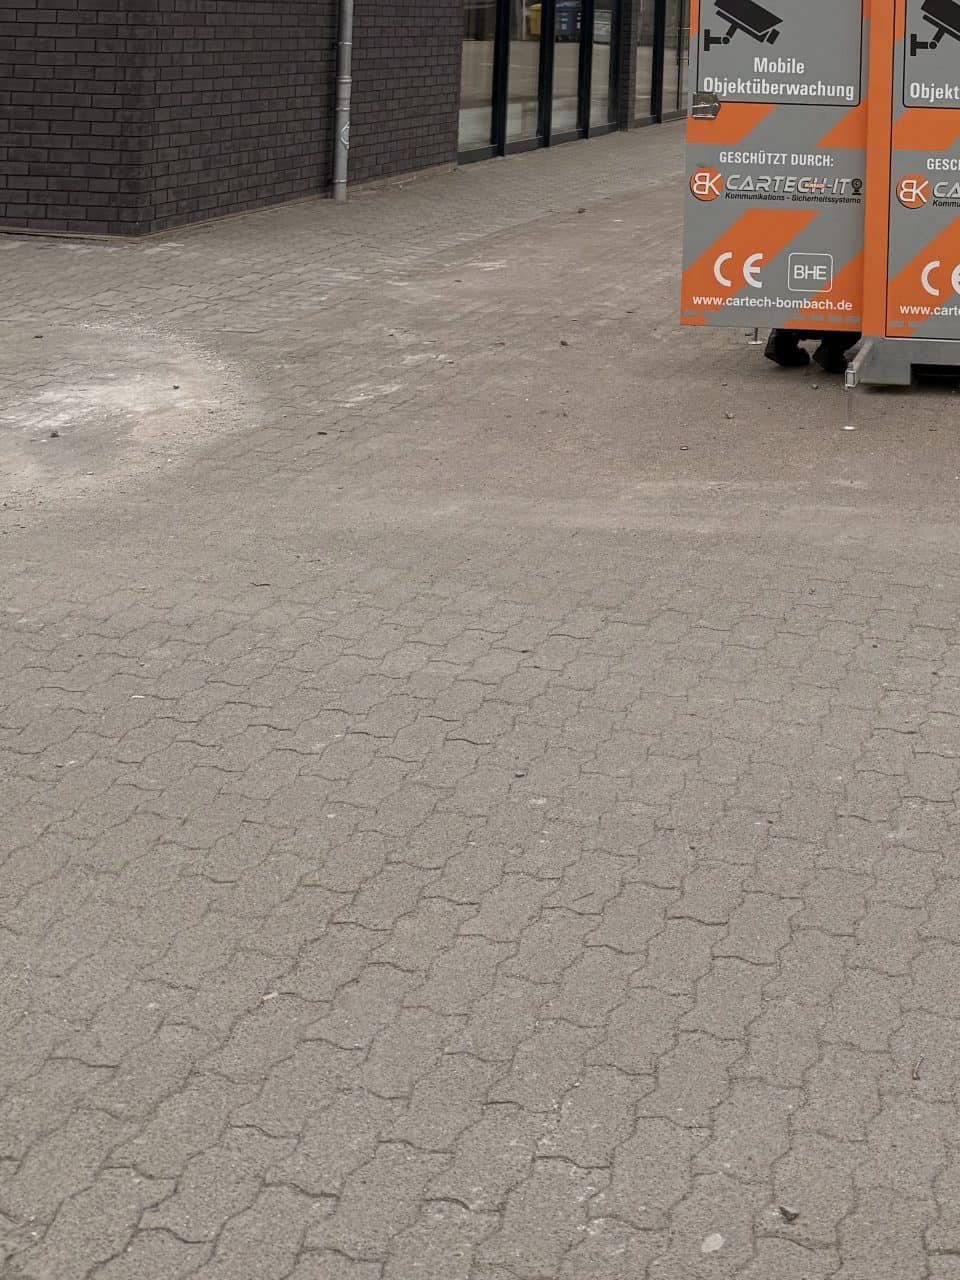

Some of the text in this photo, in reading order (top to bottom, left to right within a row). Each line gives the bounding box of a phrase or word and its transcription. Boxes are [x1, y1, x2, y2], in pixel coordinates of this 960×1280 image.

[754, 57, 805, 74] Mobile
[703, 76, 854, 100] Objektüberwachung
[719, 150, 834, 167] GESCHÜTZT DURCH:
[725, 192, 785, 201] Kommunikations
[791, 194, 861, 204] Sicherheitssysteme
[714, 252, 763, 288] CE
[793, 265, 827, 280] BHE
[692, 296, 853, 311] www.cartech-bombach.de
